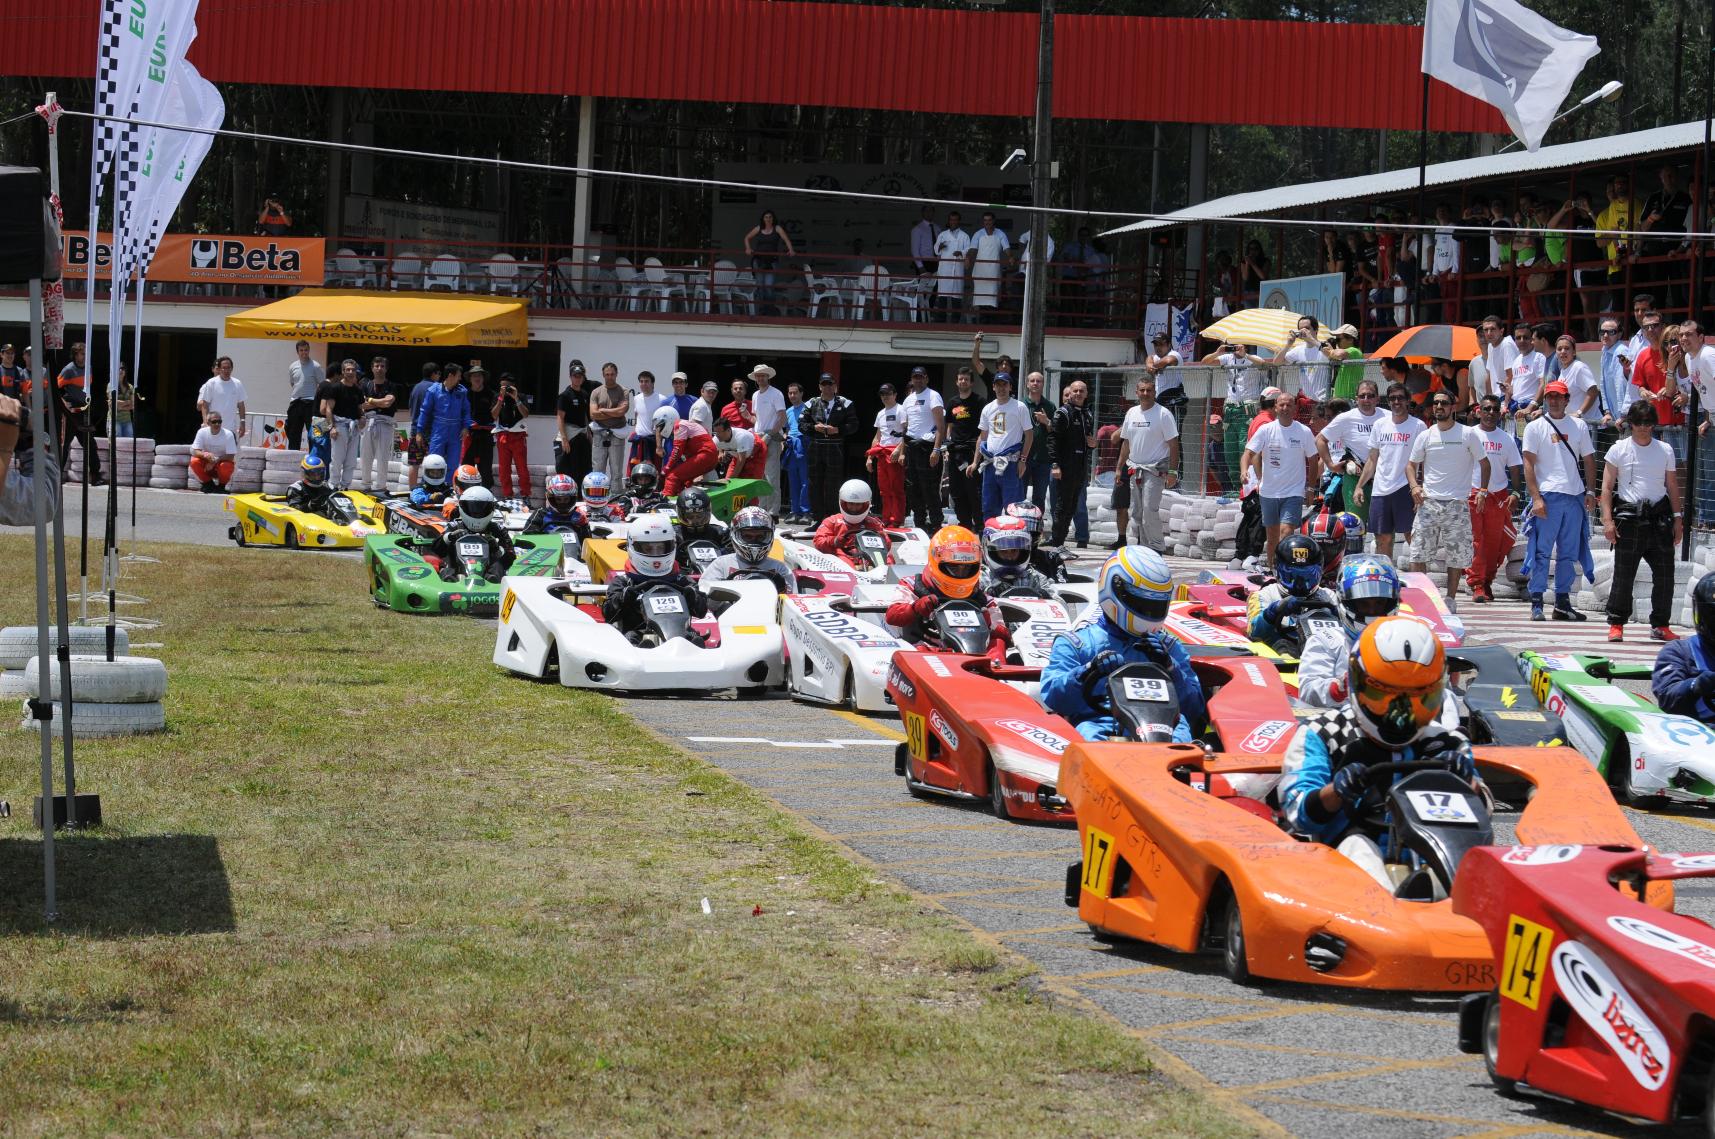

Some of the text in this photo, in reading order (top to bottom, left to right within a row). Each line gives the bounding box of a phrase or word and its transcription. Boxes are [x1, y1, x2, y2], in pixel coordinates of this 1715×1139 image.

[221, 240, 301, 271] Beta
[265, 329, 432, 344] www.pestronix.pt
[1380, 432, 1411, 443] UNITRIP
[1294, 550, 1308, 558] tvi
[655, 597, 676, 605] 129
[1130, 679, 1162, 690] 39
[908, 715, 922, 757] 39
[1419, 792, 1453, 807] 17
[1084, 832, 1109, 889] 17
[1508, 922, 1543, 1001] 74
